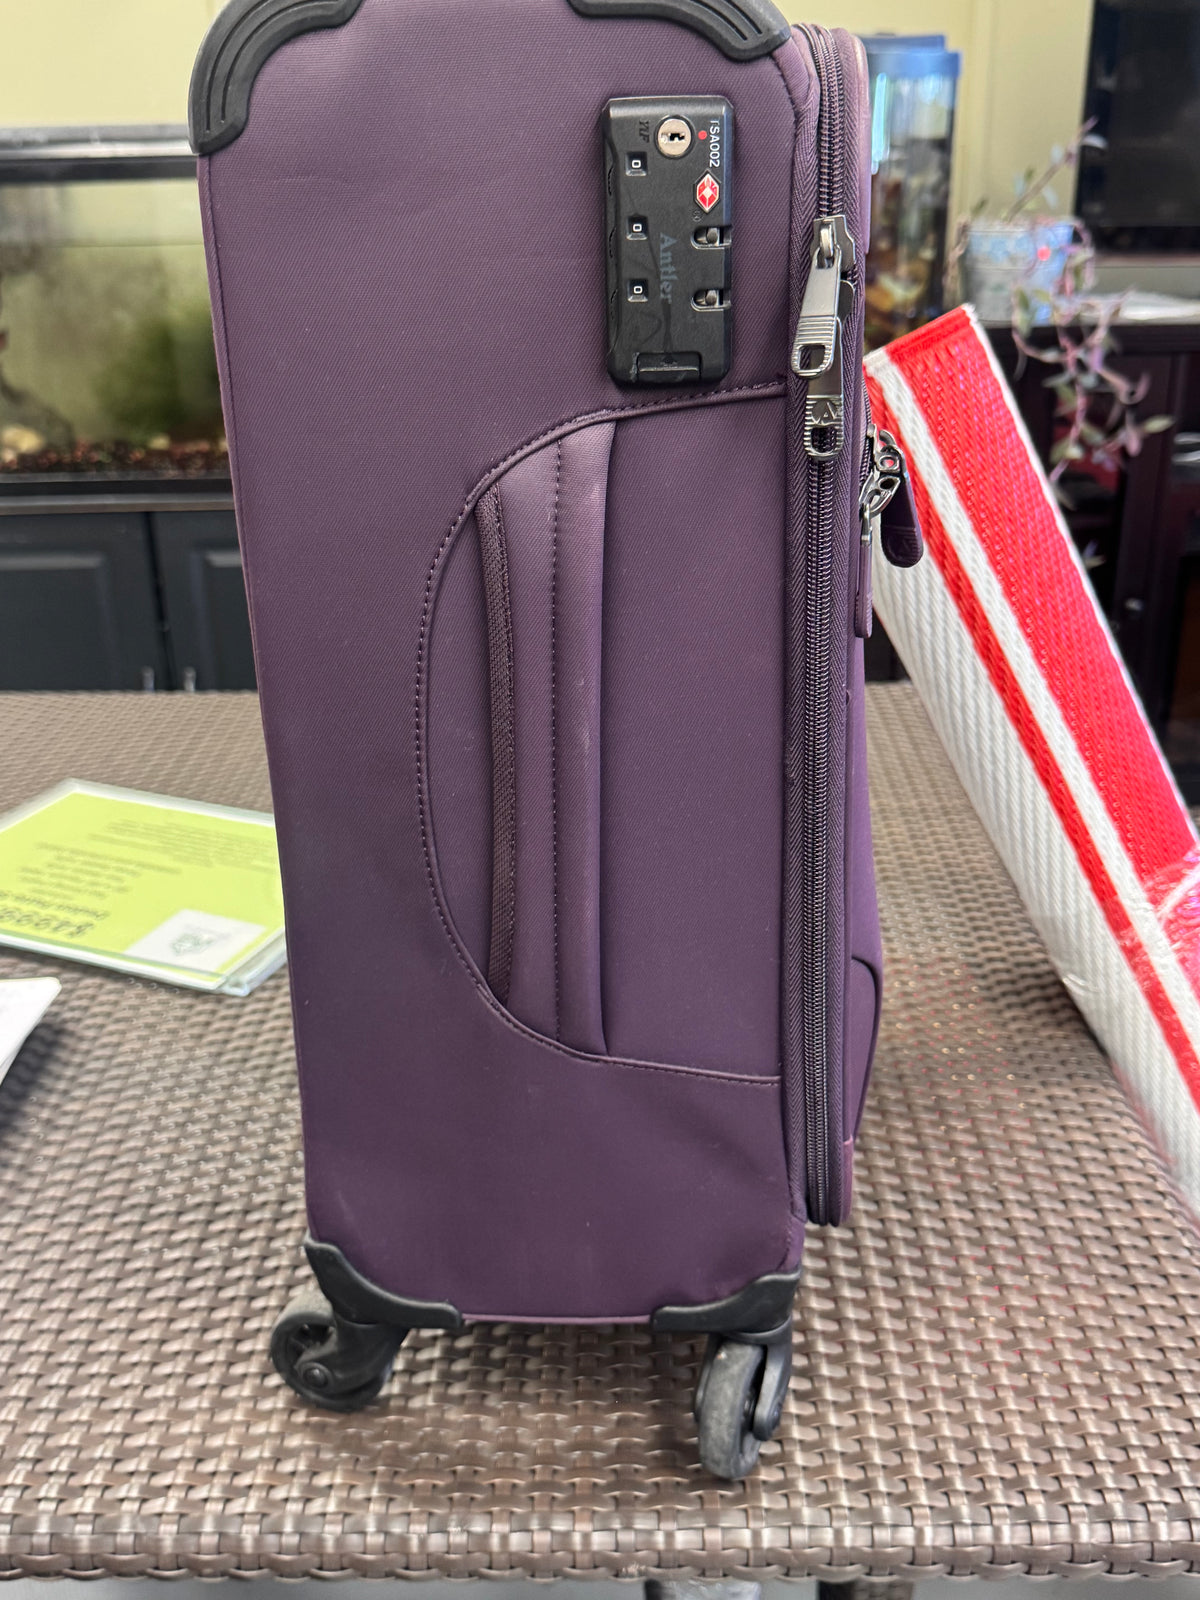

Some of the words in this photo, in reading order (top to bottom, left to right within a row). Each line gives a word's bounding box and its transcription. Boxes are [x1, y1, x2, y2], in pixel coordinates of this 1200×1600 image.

[708, 118, 721, 168] TSA002
[631, 159, 642, 169] 0
[632, 223, 643, 233] 0
[660, 231, 679, 305] Antler
[633, 285, 643, 295] 0
